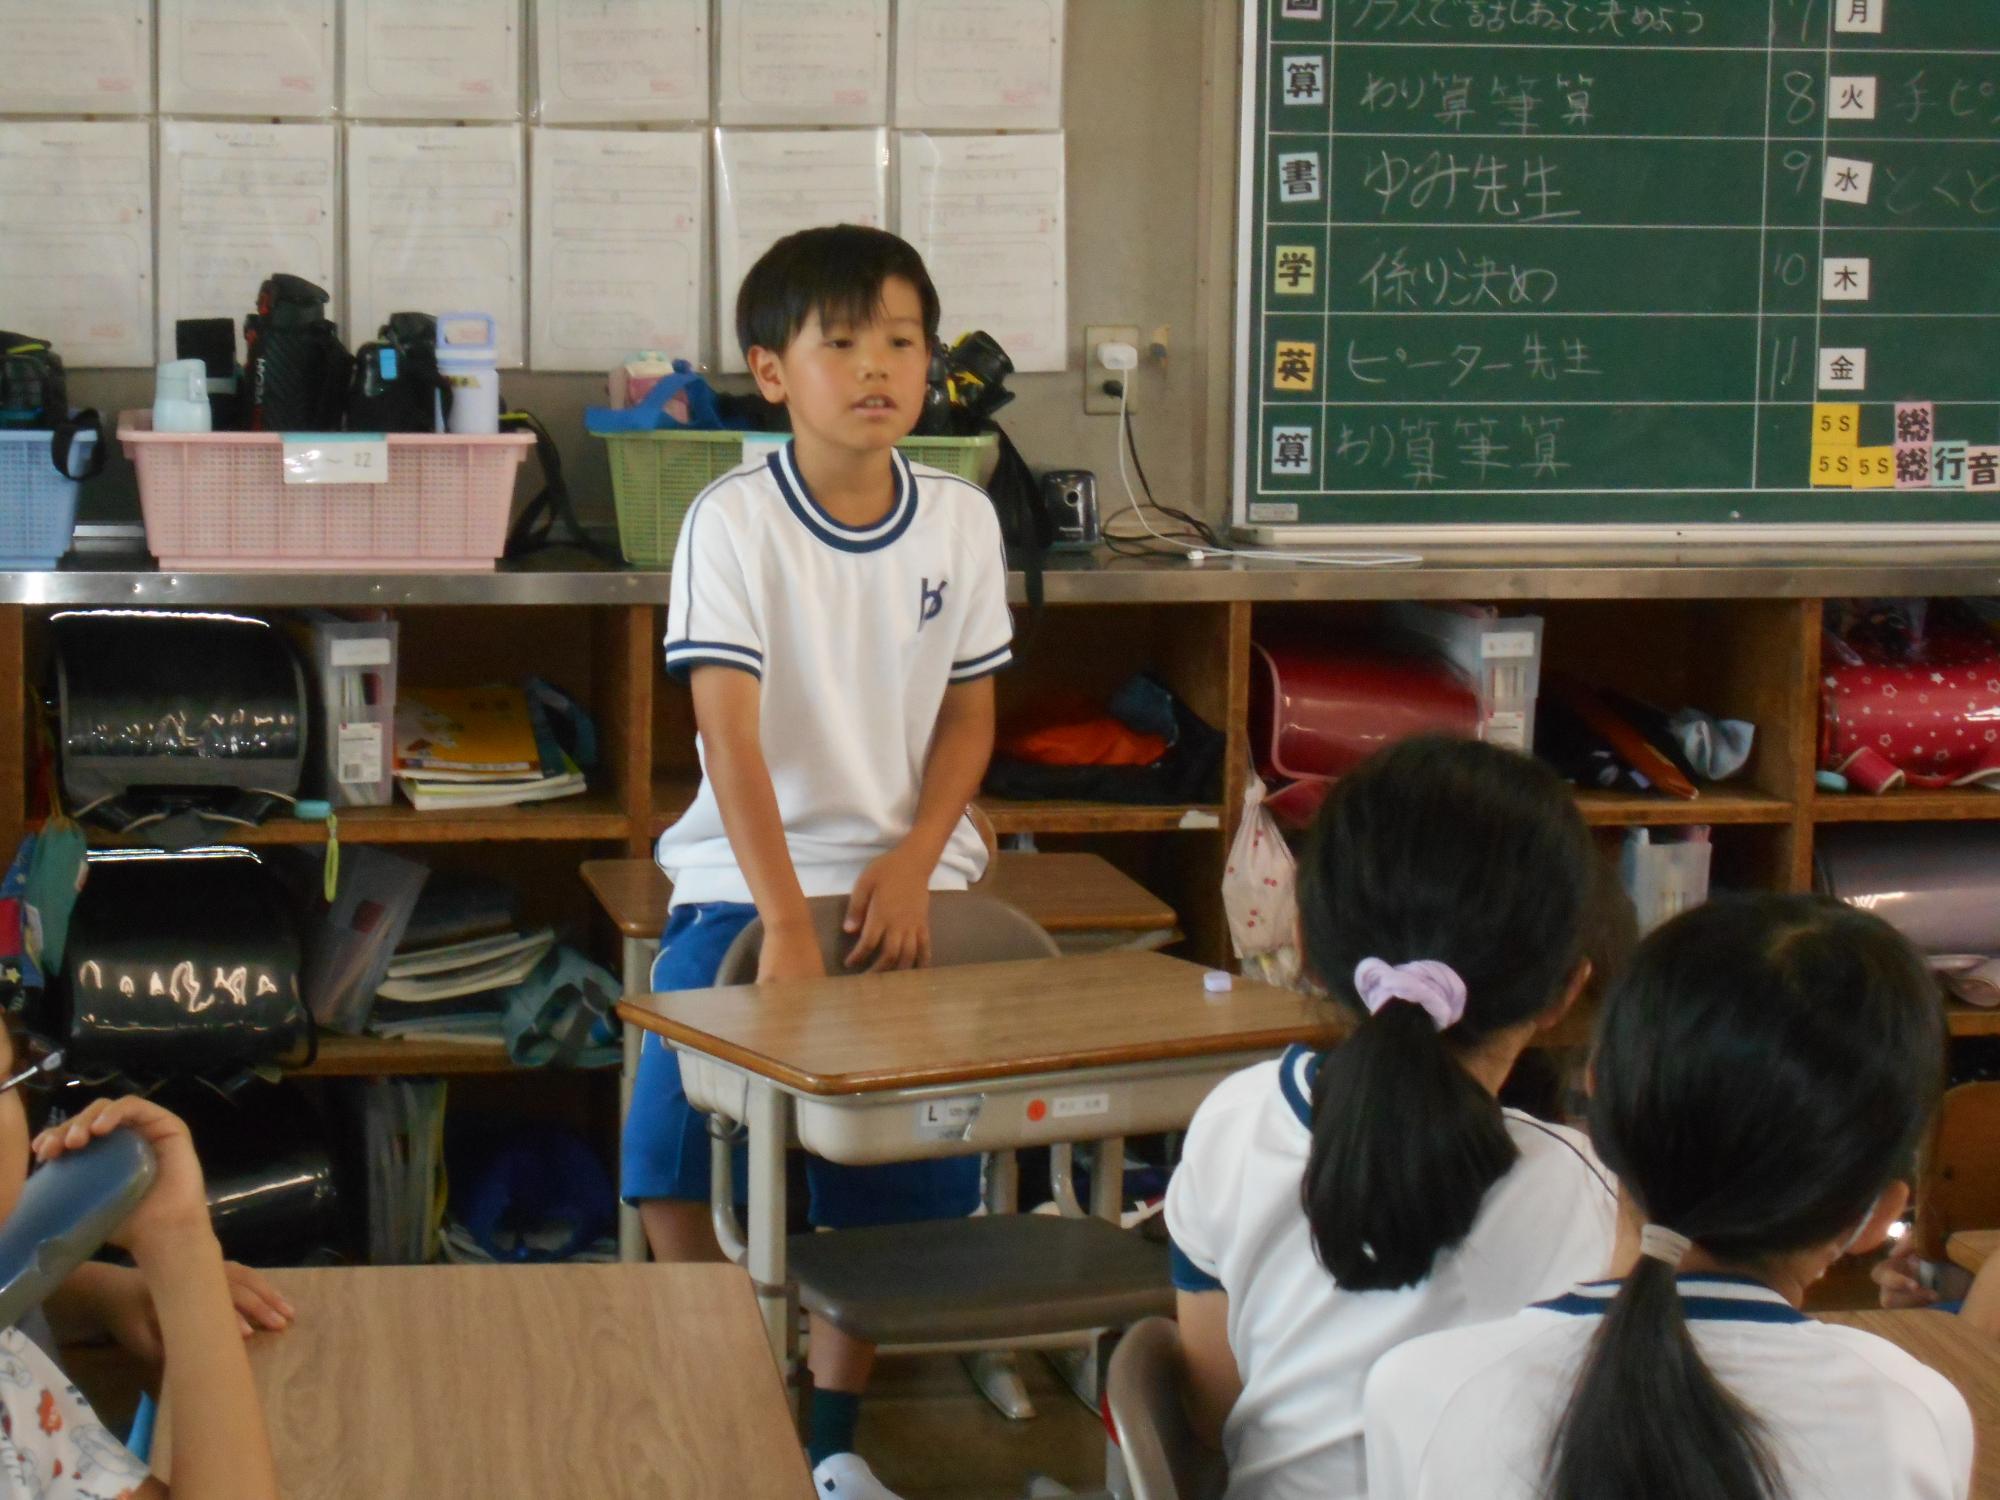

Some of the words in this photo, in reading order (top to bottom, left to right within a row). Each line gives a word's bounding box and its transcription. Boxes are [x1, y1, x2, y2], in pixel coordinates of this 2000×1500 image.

[1848, 0, 1868, 24] 月
[1285, 62, 1321, 99] 算
[1783, 70, 1816, 124] 8
[1839, 84, 1864, 110] 火
[1895, 70, 2000, 123] 手ピ
[1281, 159, 1317, 196] 書
[1363, 150, 1581, 223] ゆみ先生
[1782, 150, 1812, 195] 9
[1833, 166, 1859, 192] 水
[1277, 252, 1313, 288] 学
[1359, 246, 1558, 306] 係り決め
[1773, 252, 1806, 287] 10
[1833, 265, 1858, 292] 木
[1277, 347, 1312, 384] 英
[1829, 354, 1855, 381] 金
[1274, 432, 1309, 468] 算
[1934, 447, 1966, 481] 行
[1967, 451, 1999, 486] 音
[928, 1105, 938, 1122] L
